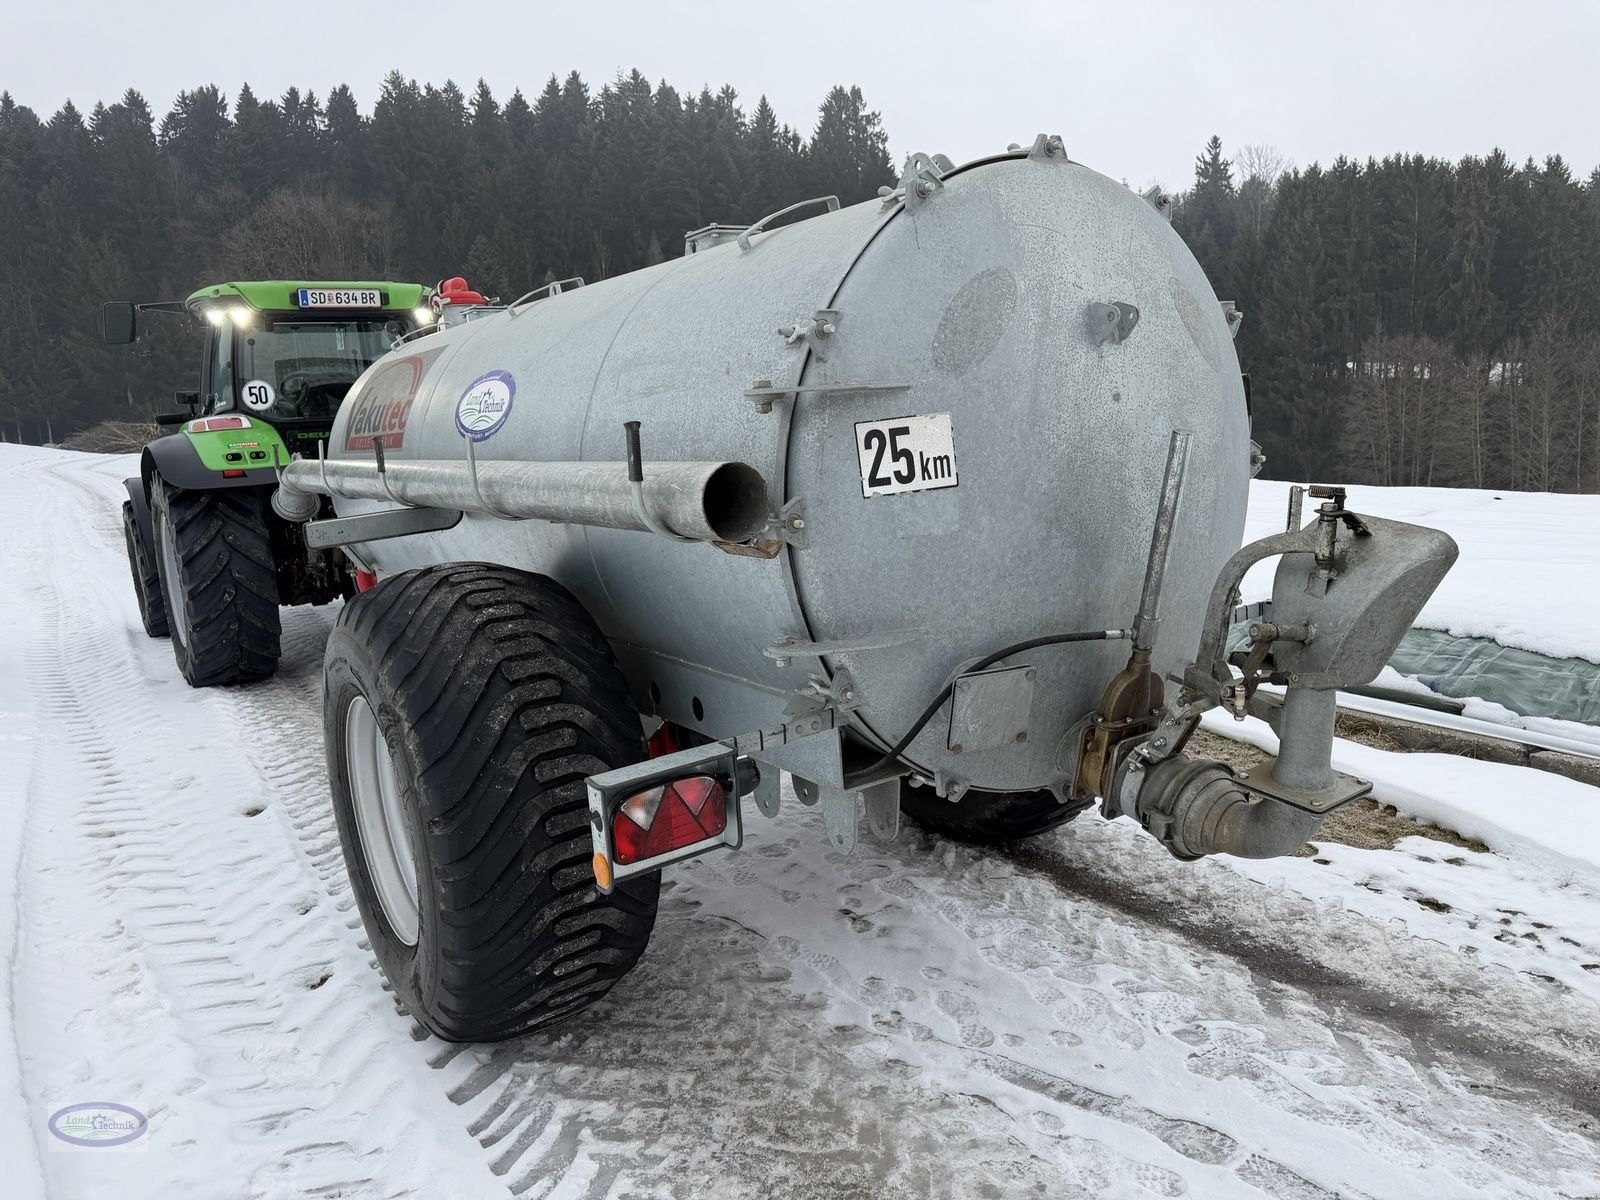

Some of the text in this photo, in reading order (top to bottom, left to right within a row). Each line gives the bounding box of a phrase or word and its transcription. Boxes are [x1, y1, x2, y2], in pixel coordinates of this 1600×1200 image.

[311, 292, 376, 304] SD 634 BR
[248, 386, 268, 405] 50
[345, 387, 413, 450] Vakutec
[297, 431, 331, 439] DEU
[864, 426, 952, 488] 25 km
